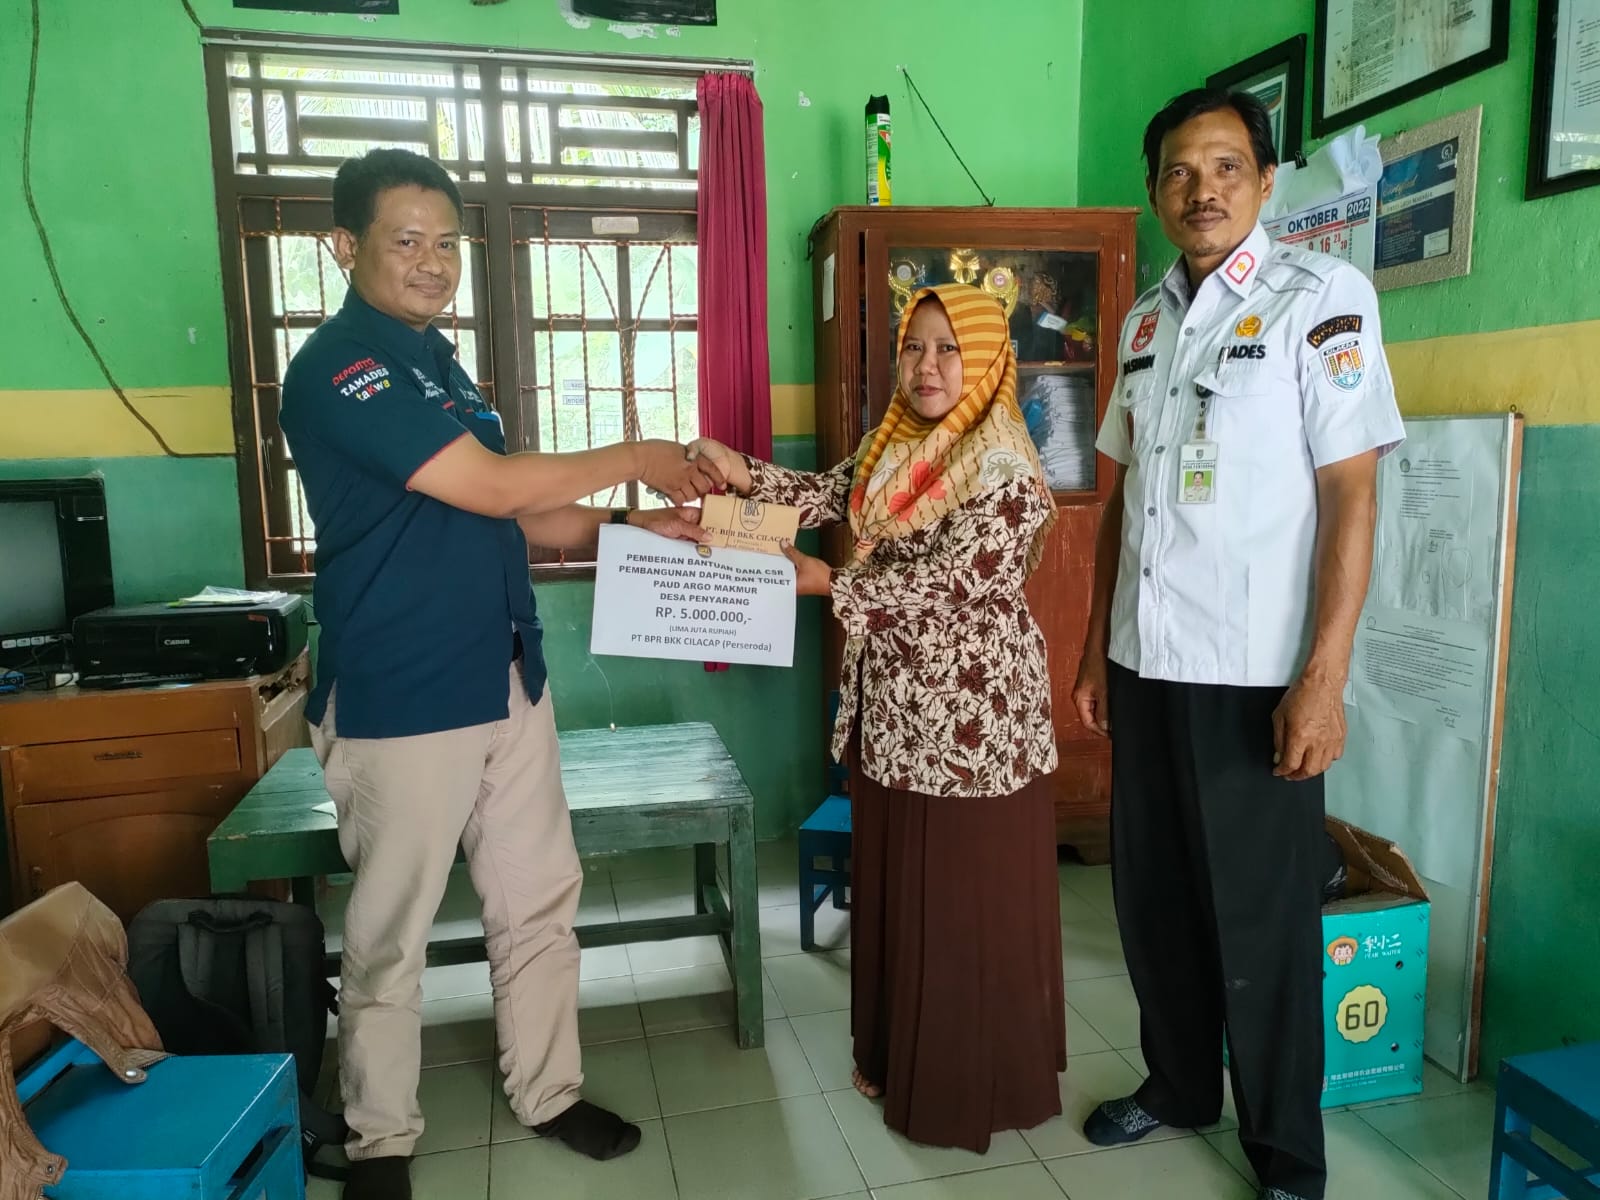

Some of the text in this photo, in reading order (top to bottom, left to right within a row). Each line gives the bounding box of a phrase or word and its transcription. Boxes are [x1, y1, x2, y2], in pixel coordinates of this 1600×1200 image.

[1287, 208, 1339, 233] OKTOBER
[1347, 198, 1371, 217] 2022
[1320, 236, 1331, 253] 16
[737, 531, 755, 540] BKK
[626, 553, 684, 565] PEMBERIAN
[687, 558, 733, 571] BANTUAN
[735, 567, 762, 575] DANA
[618, 565, 696, 578] PEMBANGUNAN
[699, 571, 732, 582] DAPUR
[757, 577, 791, 586] TOILET
[653, 580, 758, 595] PAUD ARGO MAKMUR
[660, 592, 750, 606] DESA PENYARANG
[655, 606, 752, 625] RP. 5.000.000,-
[669, 625, 737, 636] (LIMA JUTA RUPIAH)
[631, 634, 772, 652] PT BPR BKK CILACAP (Perseroda)
[1344, 1000, 1380, 1031] 60
